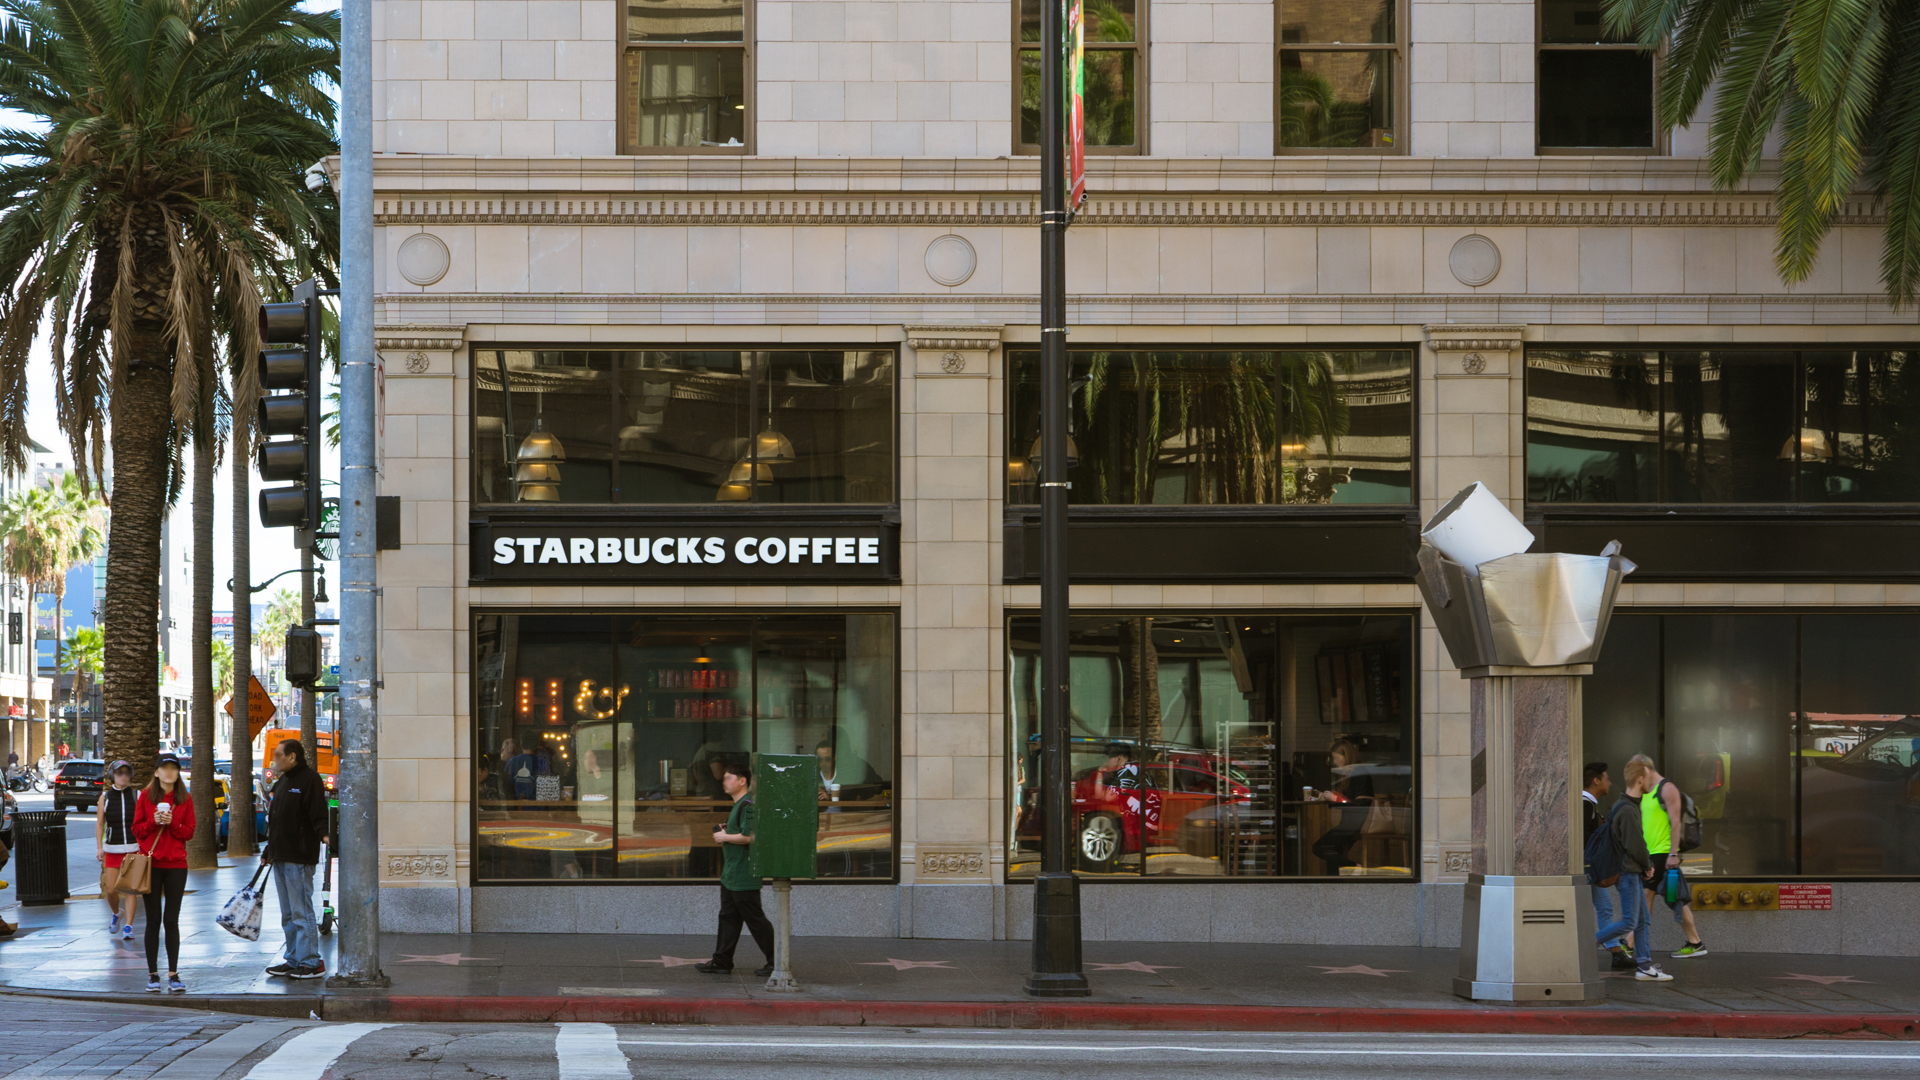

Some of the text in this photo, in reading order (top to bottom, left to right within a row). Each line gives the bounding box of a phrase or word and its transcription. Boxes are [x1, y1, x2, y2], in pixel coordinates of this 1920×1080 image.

[493, 536, 879, 564] STARBUCKS COFFEE
[248, 692, 262, 700] OAD
[249, 704, 262, 712] ORK
[316, 716, 331, 726] cal
